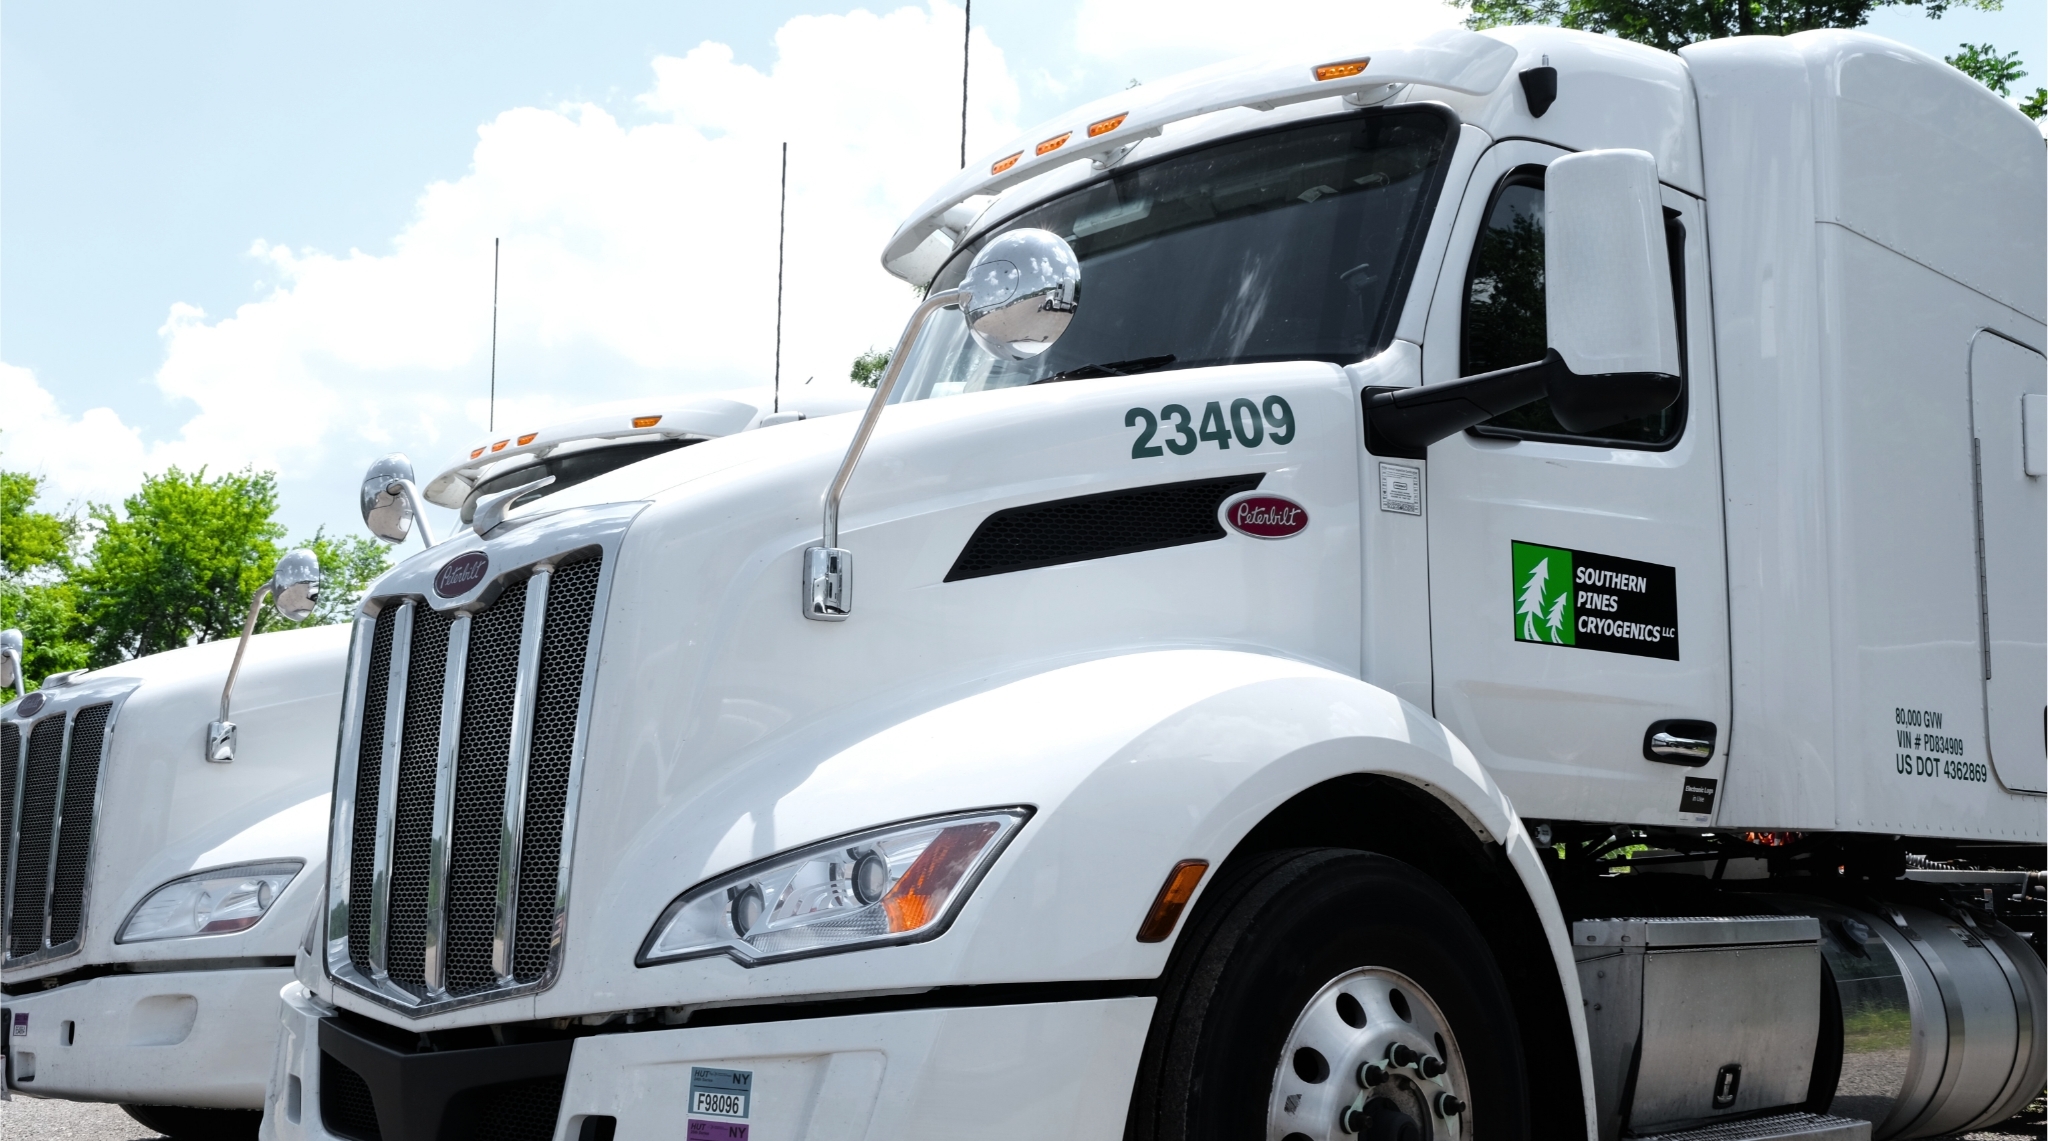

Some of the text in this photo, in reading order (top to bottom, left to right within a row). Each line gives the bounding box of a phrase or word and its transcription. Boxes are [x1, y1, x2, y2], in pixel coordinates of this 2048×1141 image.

[1124, 394, 1296, 460] 23409
[1237, 502, 1302, 527] Peterbilt
[440, 560, 486, 589] Peterbilt
[1576, 567, 1646, 593] SOUTHERN
[1577, 591, 1618, 612] PINES
[1578, 615, 1661, 642] CRYOGENICS
[1662, 627, 1675, 637] LLC
[1895, 707, 1942, 729] 80,000 GVW
[1897, 730, 1963, 756] VIN # PD834909
[1896, 753, 1987, 782] US DOT 4362869
[733, 1073, 749, 1085] NY
[697, 1093, 739, 1114] F98096
[729, 1126, 746, 1138] NY
